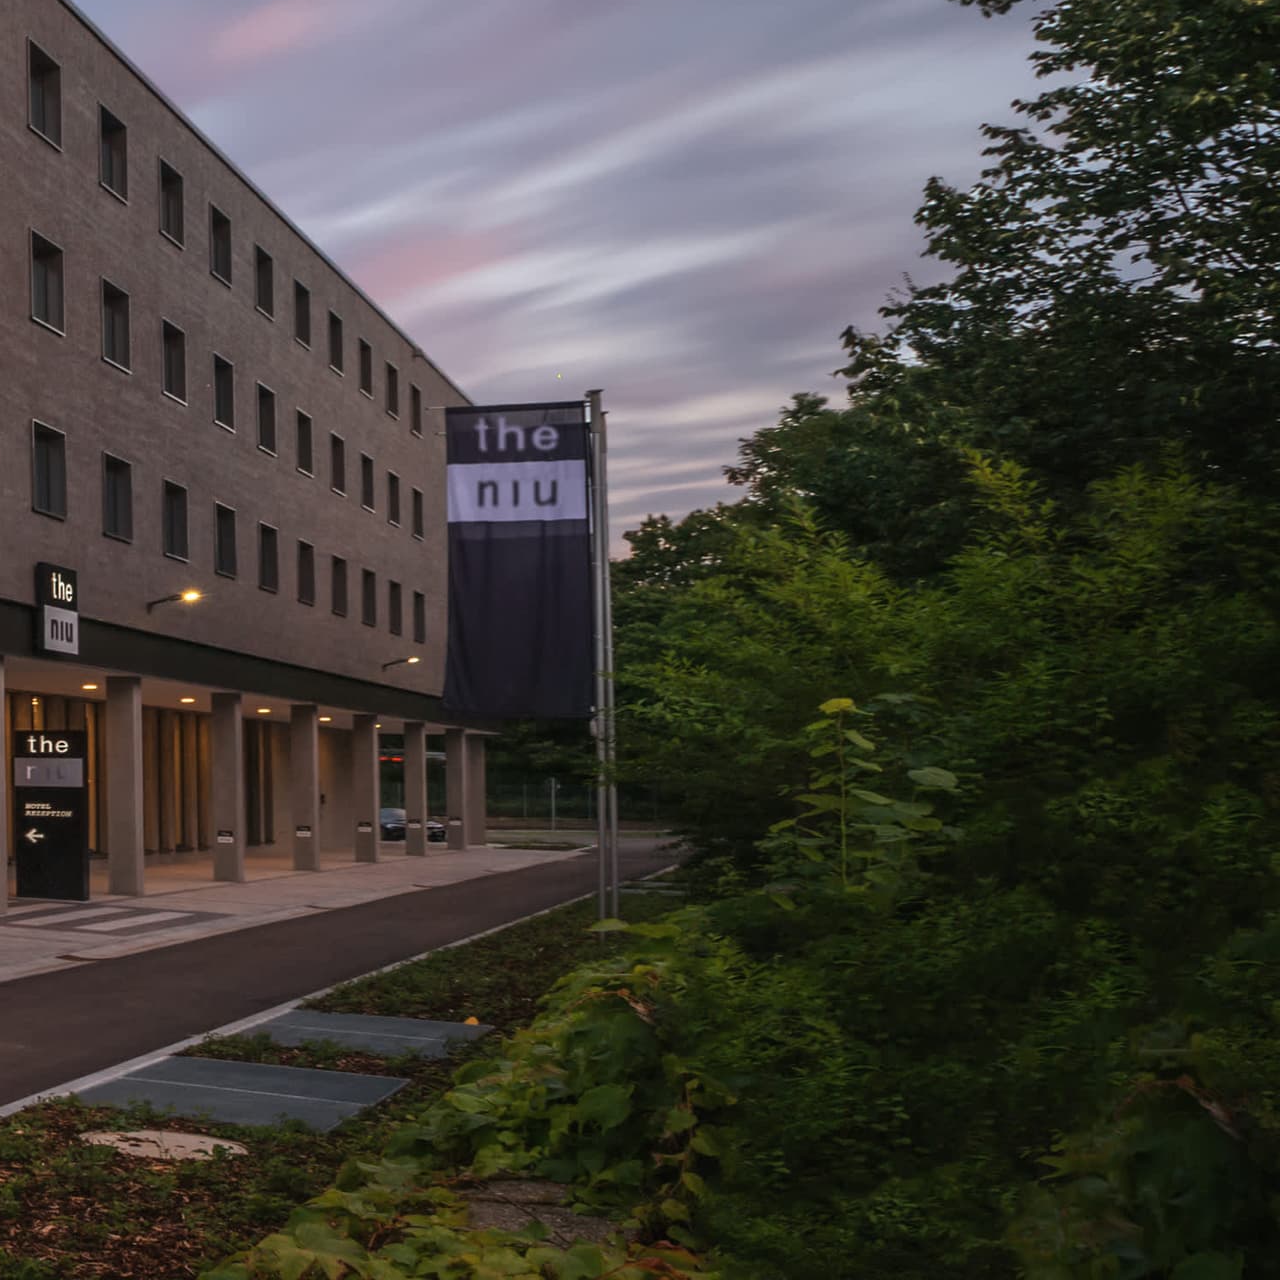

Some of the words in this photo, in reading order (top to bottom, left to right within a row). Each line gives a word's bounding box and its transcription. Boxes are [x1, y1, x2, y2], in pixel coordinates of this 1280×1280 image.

[475, 416, 560, 452] the
[51, 572, 73, 602] the
[27, 735, 69, 753] the
